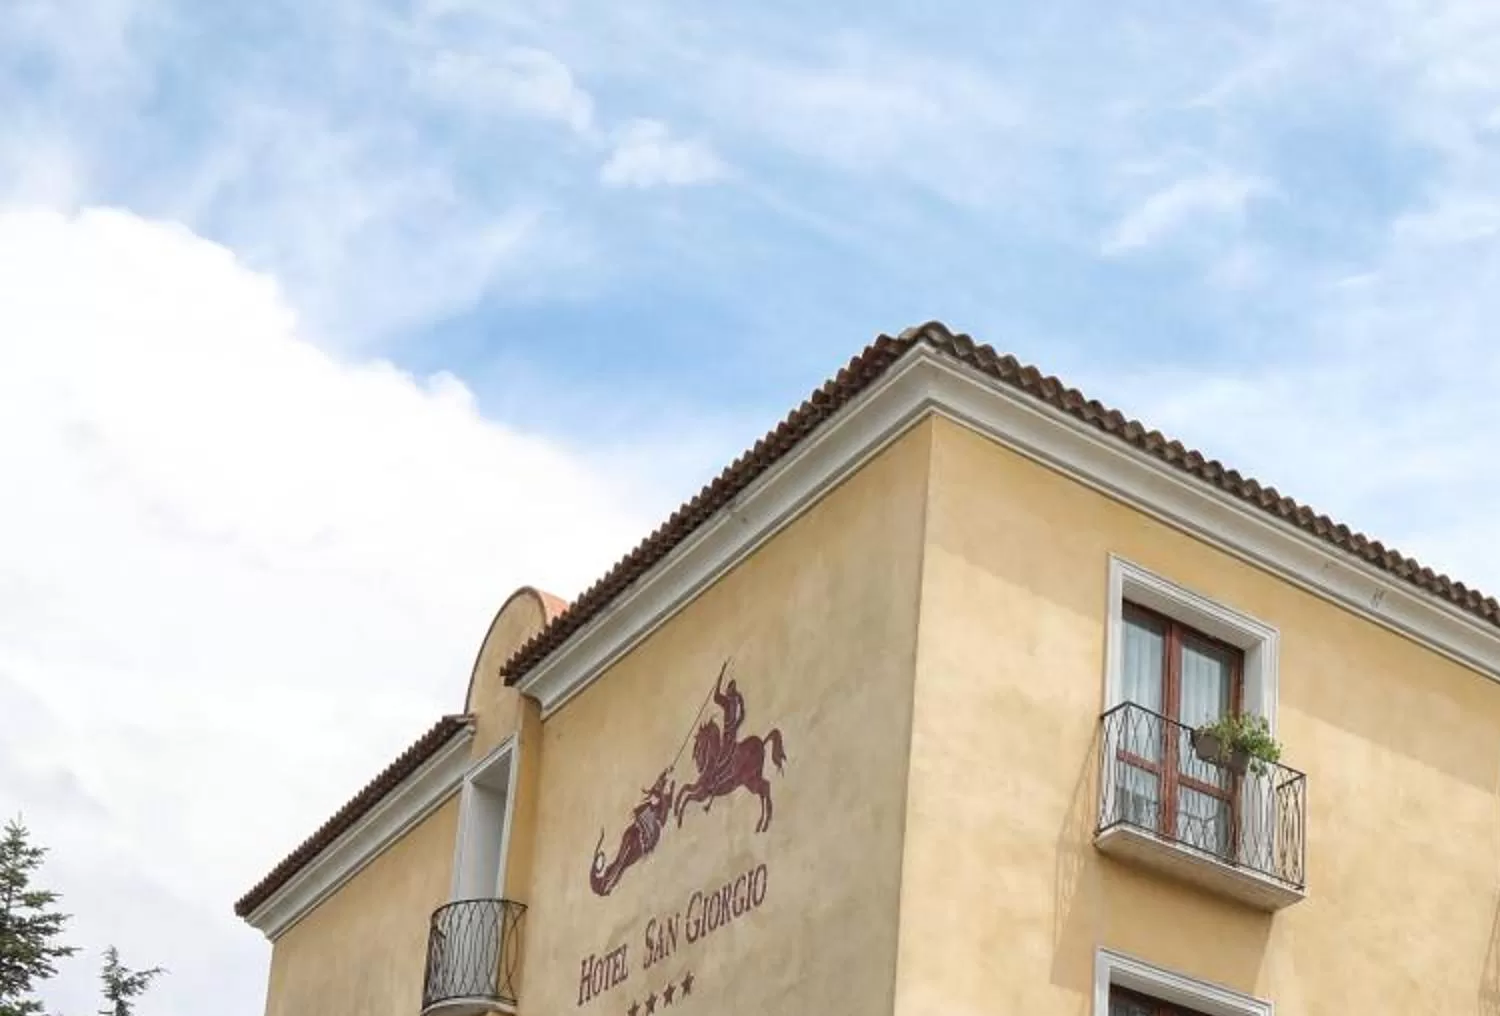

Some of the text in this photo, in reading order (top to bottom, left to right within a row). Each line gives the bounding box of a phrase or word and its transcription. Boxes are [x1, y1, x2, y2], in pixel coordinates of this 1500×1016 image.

[577, 863, 768, 1007] HOTEL SAN GIORGIO
